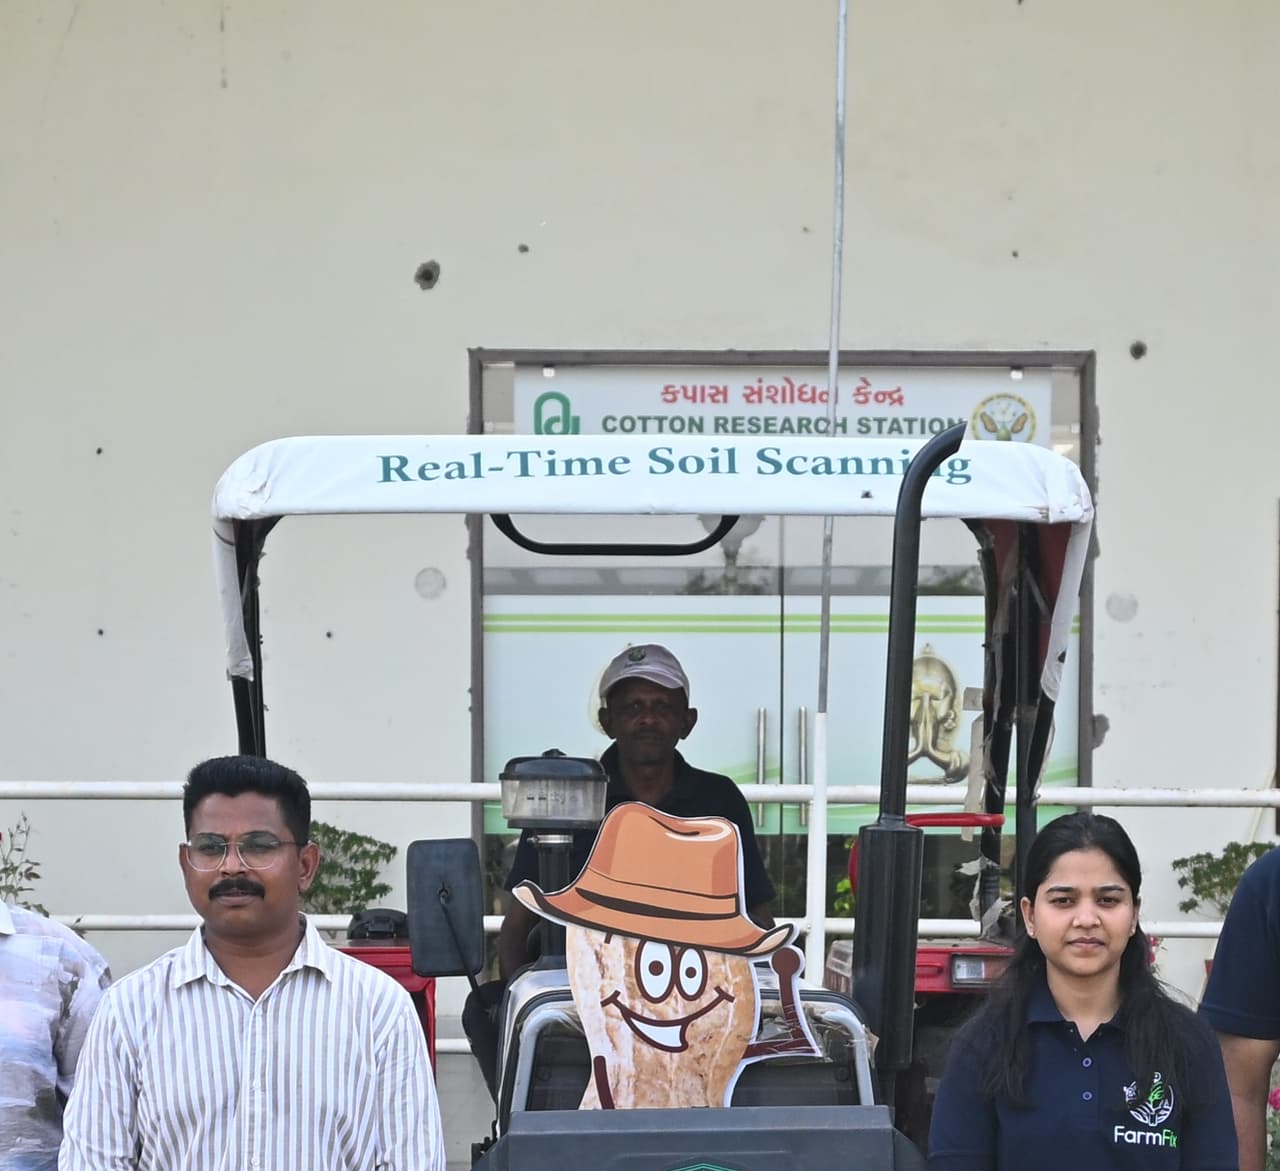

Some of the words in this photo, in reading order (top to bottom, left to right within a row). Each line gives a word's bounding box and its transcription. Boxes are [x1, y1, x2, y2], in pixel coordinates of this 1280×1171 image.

[661, 384, 729, 404] કપાસ
[742, 377, 838, 404] સંશોધન
[852, 377, 904, 406] કેન્દ્ર
[602, 415, 705, 434] COTTON
[713, 415, 847, 434] RESEARCH
[376, 447, 631, 484] Real-Time
[648, 447, 737, 476] Soil
[756, 446, 972, 485] Scannig
[1114, 1126, 1179, 1149] FarmFix
